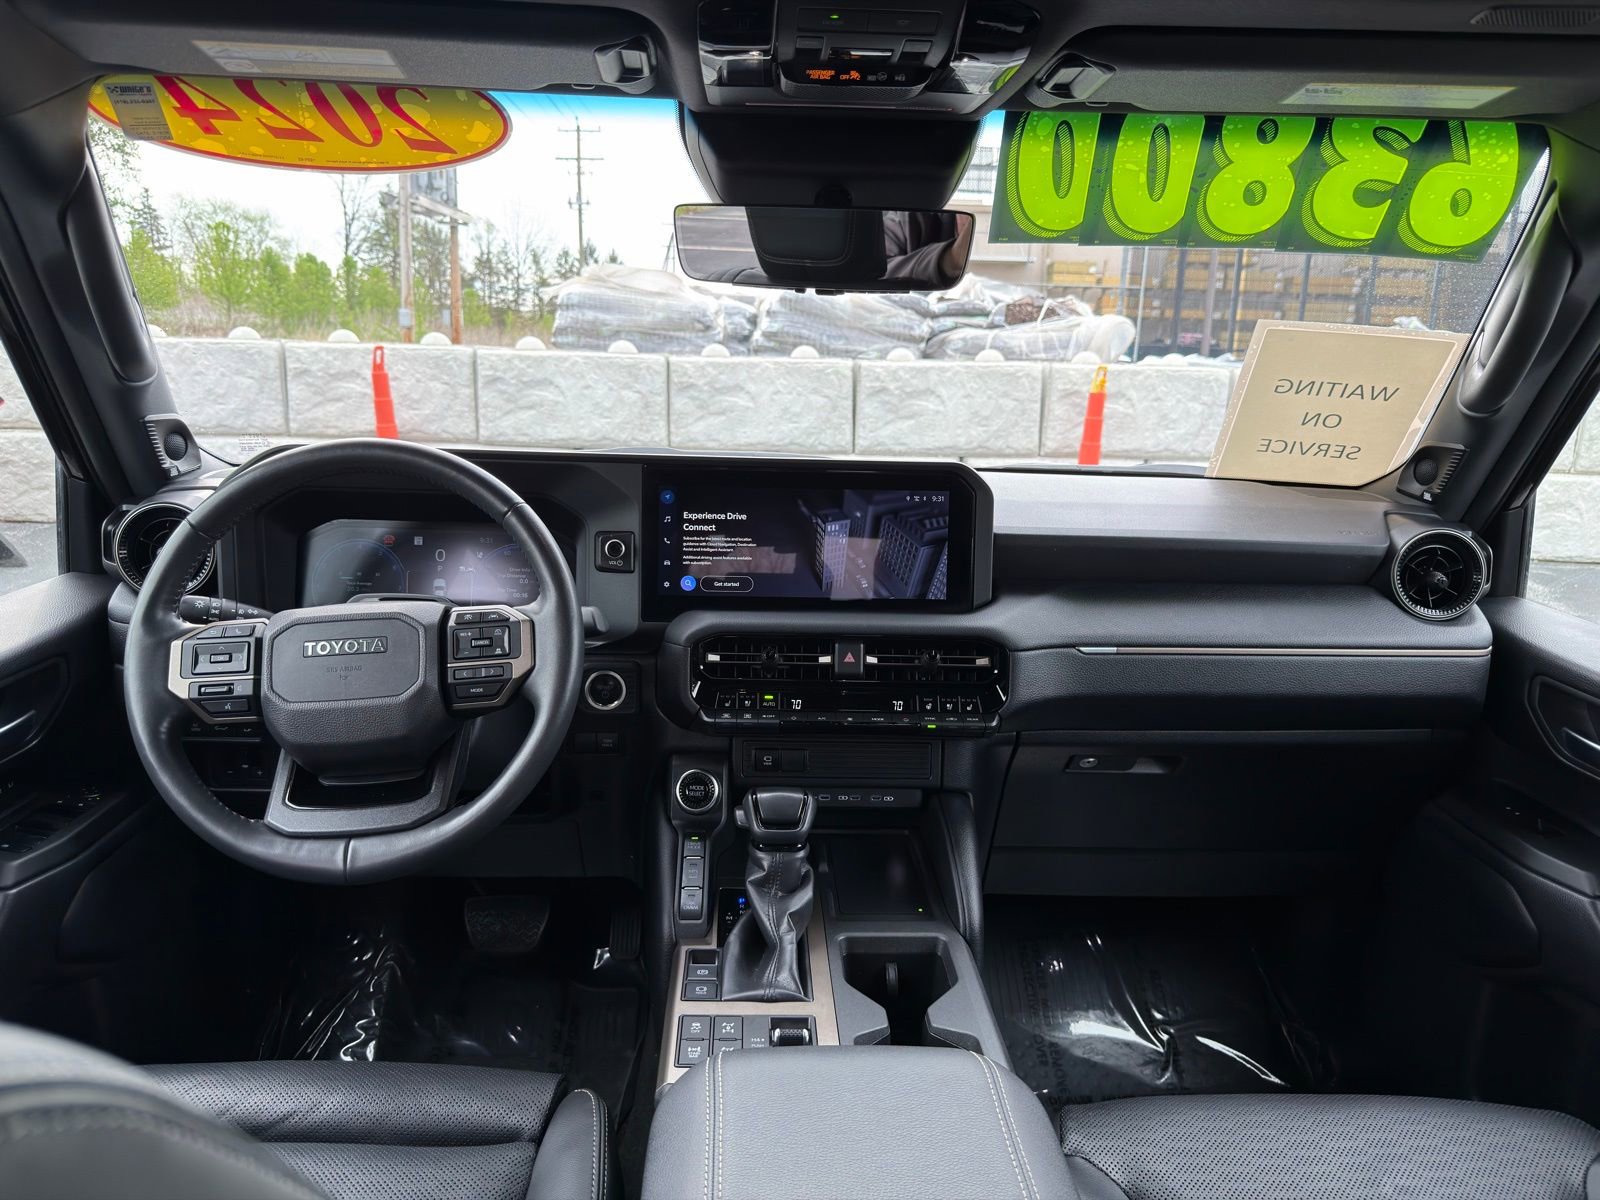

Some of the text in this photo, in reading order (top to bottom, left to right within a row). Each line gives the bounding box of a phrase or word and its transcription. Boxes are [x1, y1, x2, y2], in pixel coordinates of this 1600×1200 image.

[683, 511, 747, 521] Experience Drive
[683, 523, 716, 532] Connect
[435, 548, 446, 562] 0
[437, 565, 443, 573] P
[303, 638, 385, 656] TOYOTA
[791, 699, 802, 710] 70
[892, 701, 904, 711] 70
